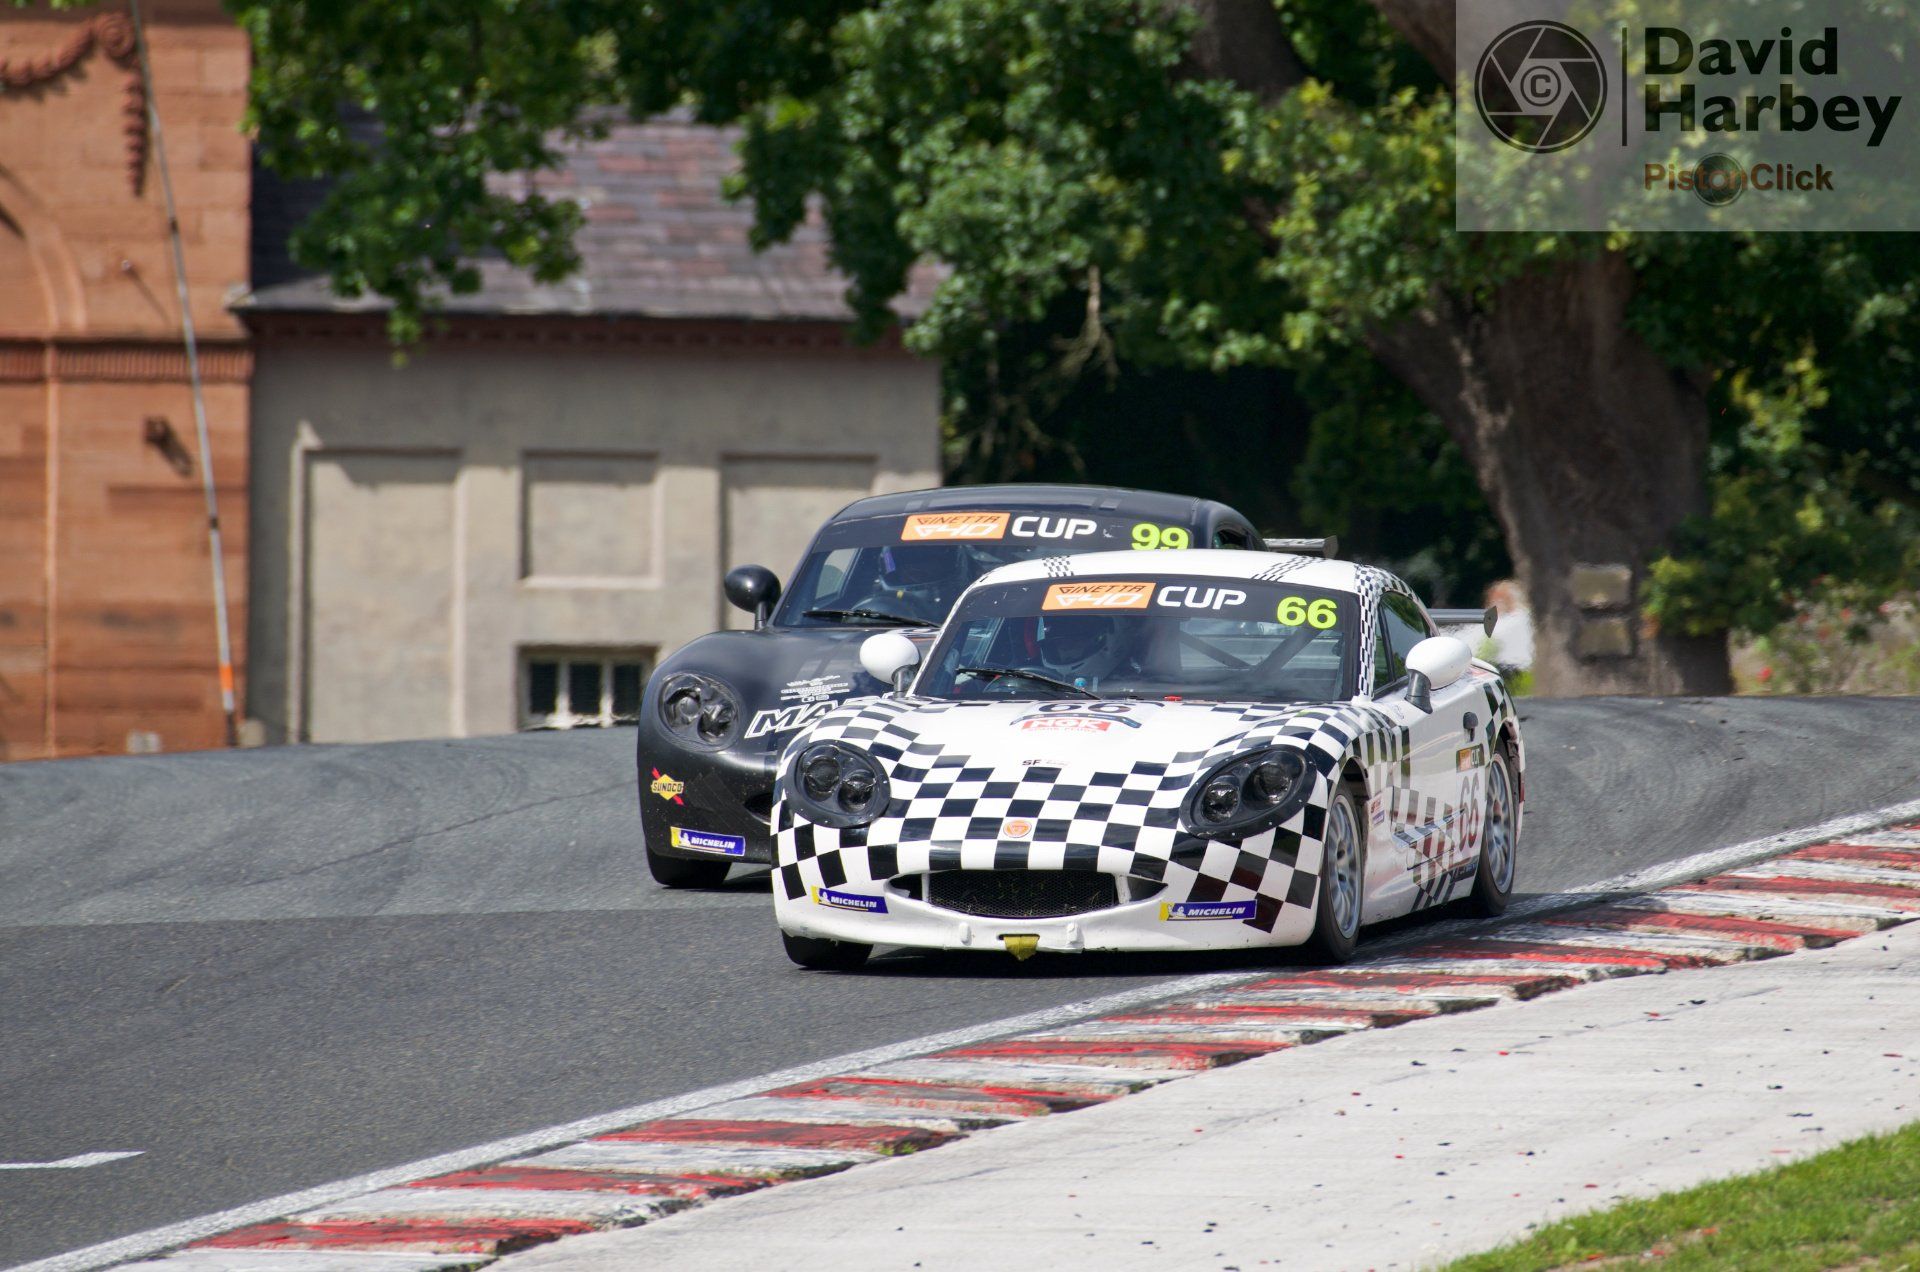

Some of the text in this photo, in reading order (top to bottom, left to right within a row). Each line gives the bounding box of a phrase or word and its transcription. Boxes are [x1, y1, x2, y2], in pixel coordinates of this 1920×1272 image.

[916, 515, 1003, 526] GINETTA
[1011, 516, 1097, 540] CUP
[1131, 523, 1190, 551] 99
[1058, 584, 1147, 595] GINETTA
[1157, 586, 1247, 610] CUP
[1276, 596, 1338, 628] 66
[652, 782, 683, 793] SUNOCO
[1459, 772, 1480, 852] 66
[691, 836, 736, 849] MICHELIN
[830, 896, 877, 908] MICHELIN
[1187, 906, 1246, 916] MICHELIN
